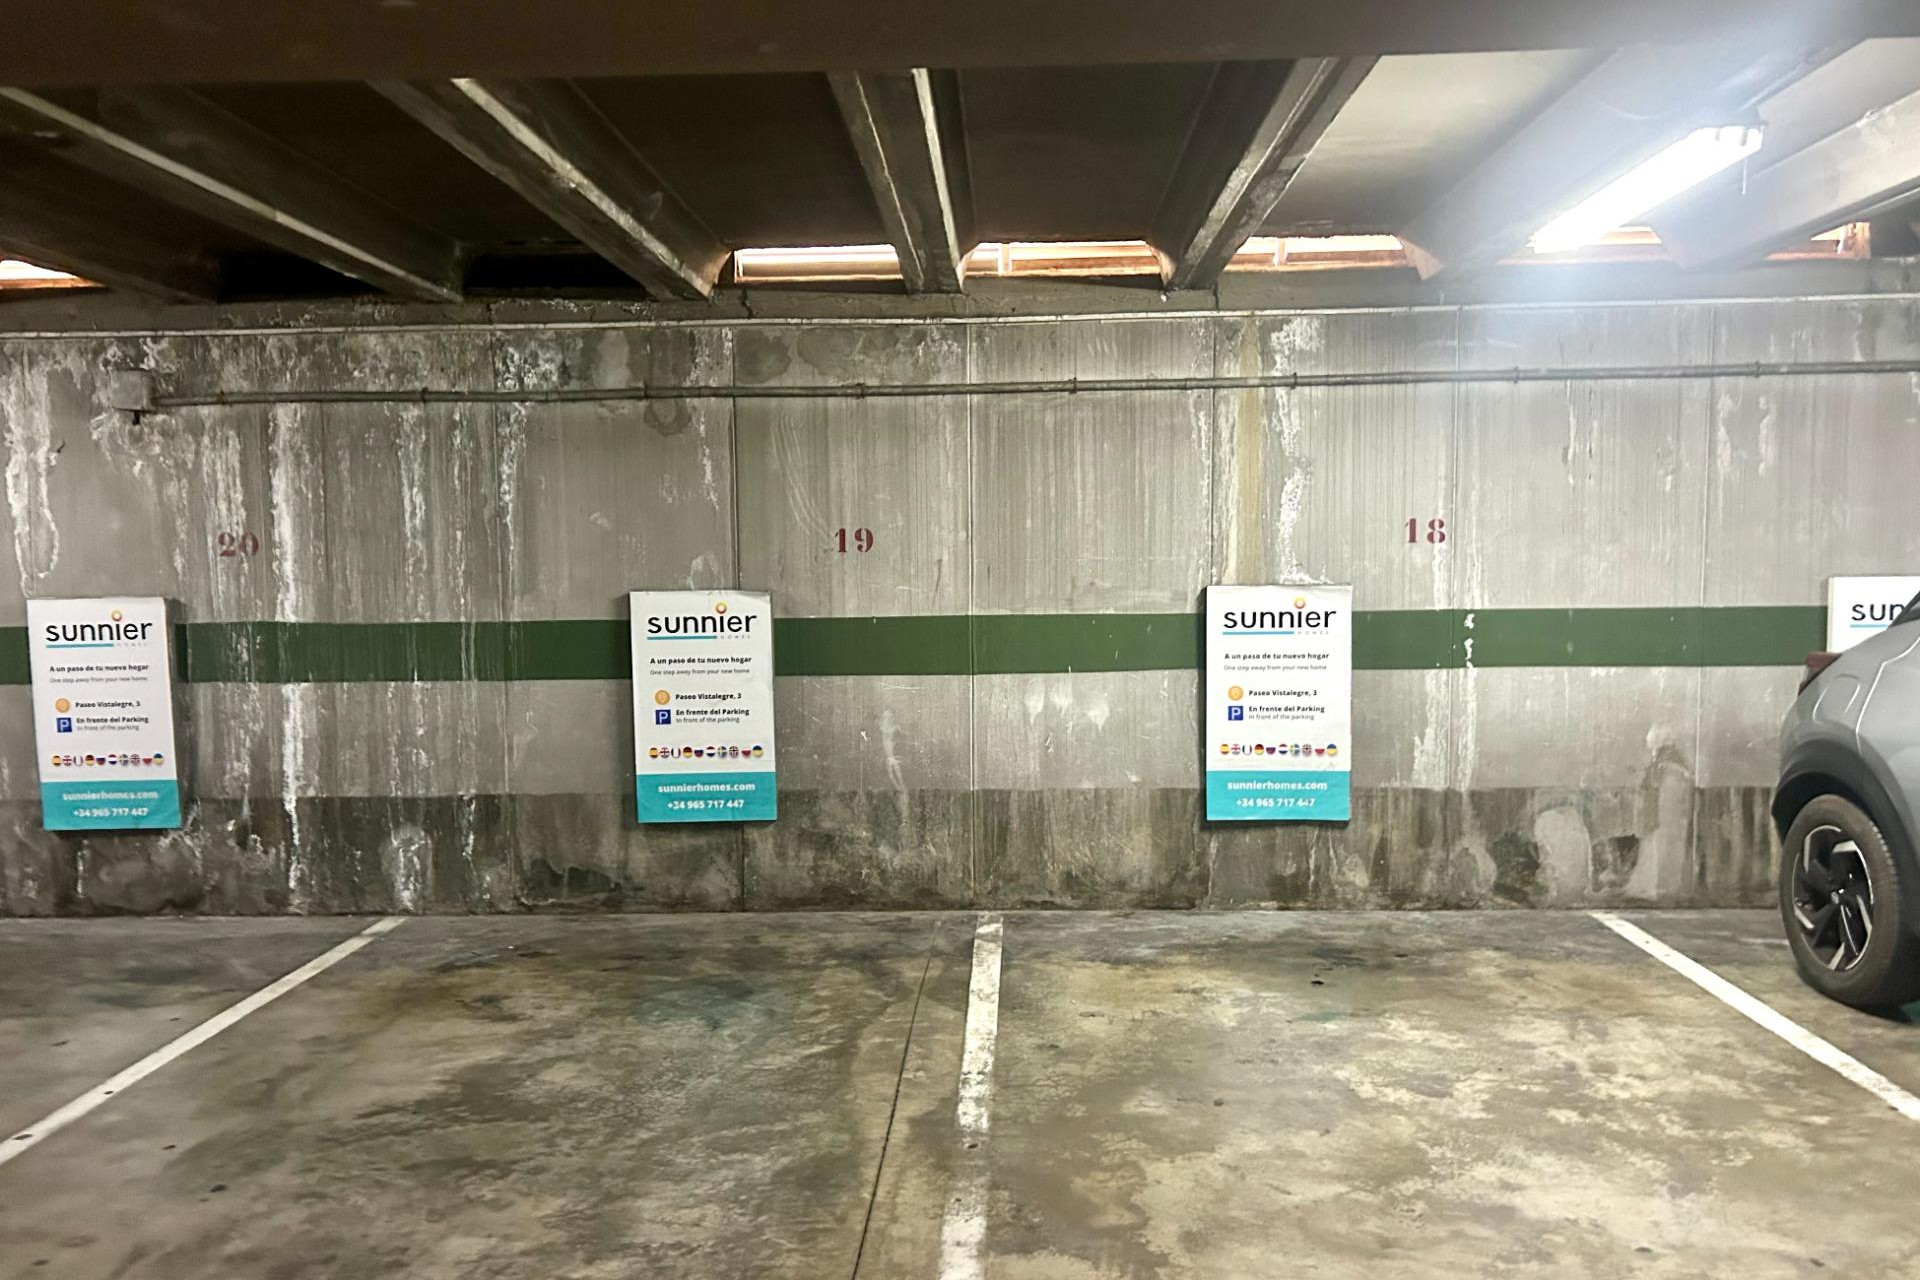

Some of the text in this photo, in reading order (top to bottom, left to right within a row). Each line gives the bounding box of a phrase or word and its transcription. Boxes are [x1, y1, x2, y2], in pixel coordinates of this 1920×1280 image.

[1404, 518, 1446, 543] 18
[218, 531, 259, 557] 20
[834, 528, 874, 552] 19
[647, 602, 757, 633] sunnier
[1223, 597, 1337, 629] sunnier
[46, 610, 152, 641] sunnier
[731, 656, 752, 664] hogar
[1308, 652, 1329, 660] hogar
[658, 782, 756, 793] sunnierhomes.com
[1227, 780, 1328, 791] sunnierhomes.com
[62, 790, 159, 801] sunnierhomes.com
[667, 799, 745, 810] +34 965 717 447
[1236, 798, 1316, 807] +34 965 717 447
[73, 807, 149, 817] +34 965 717 447
